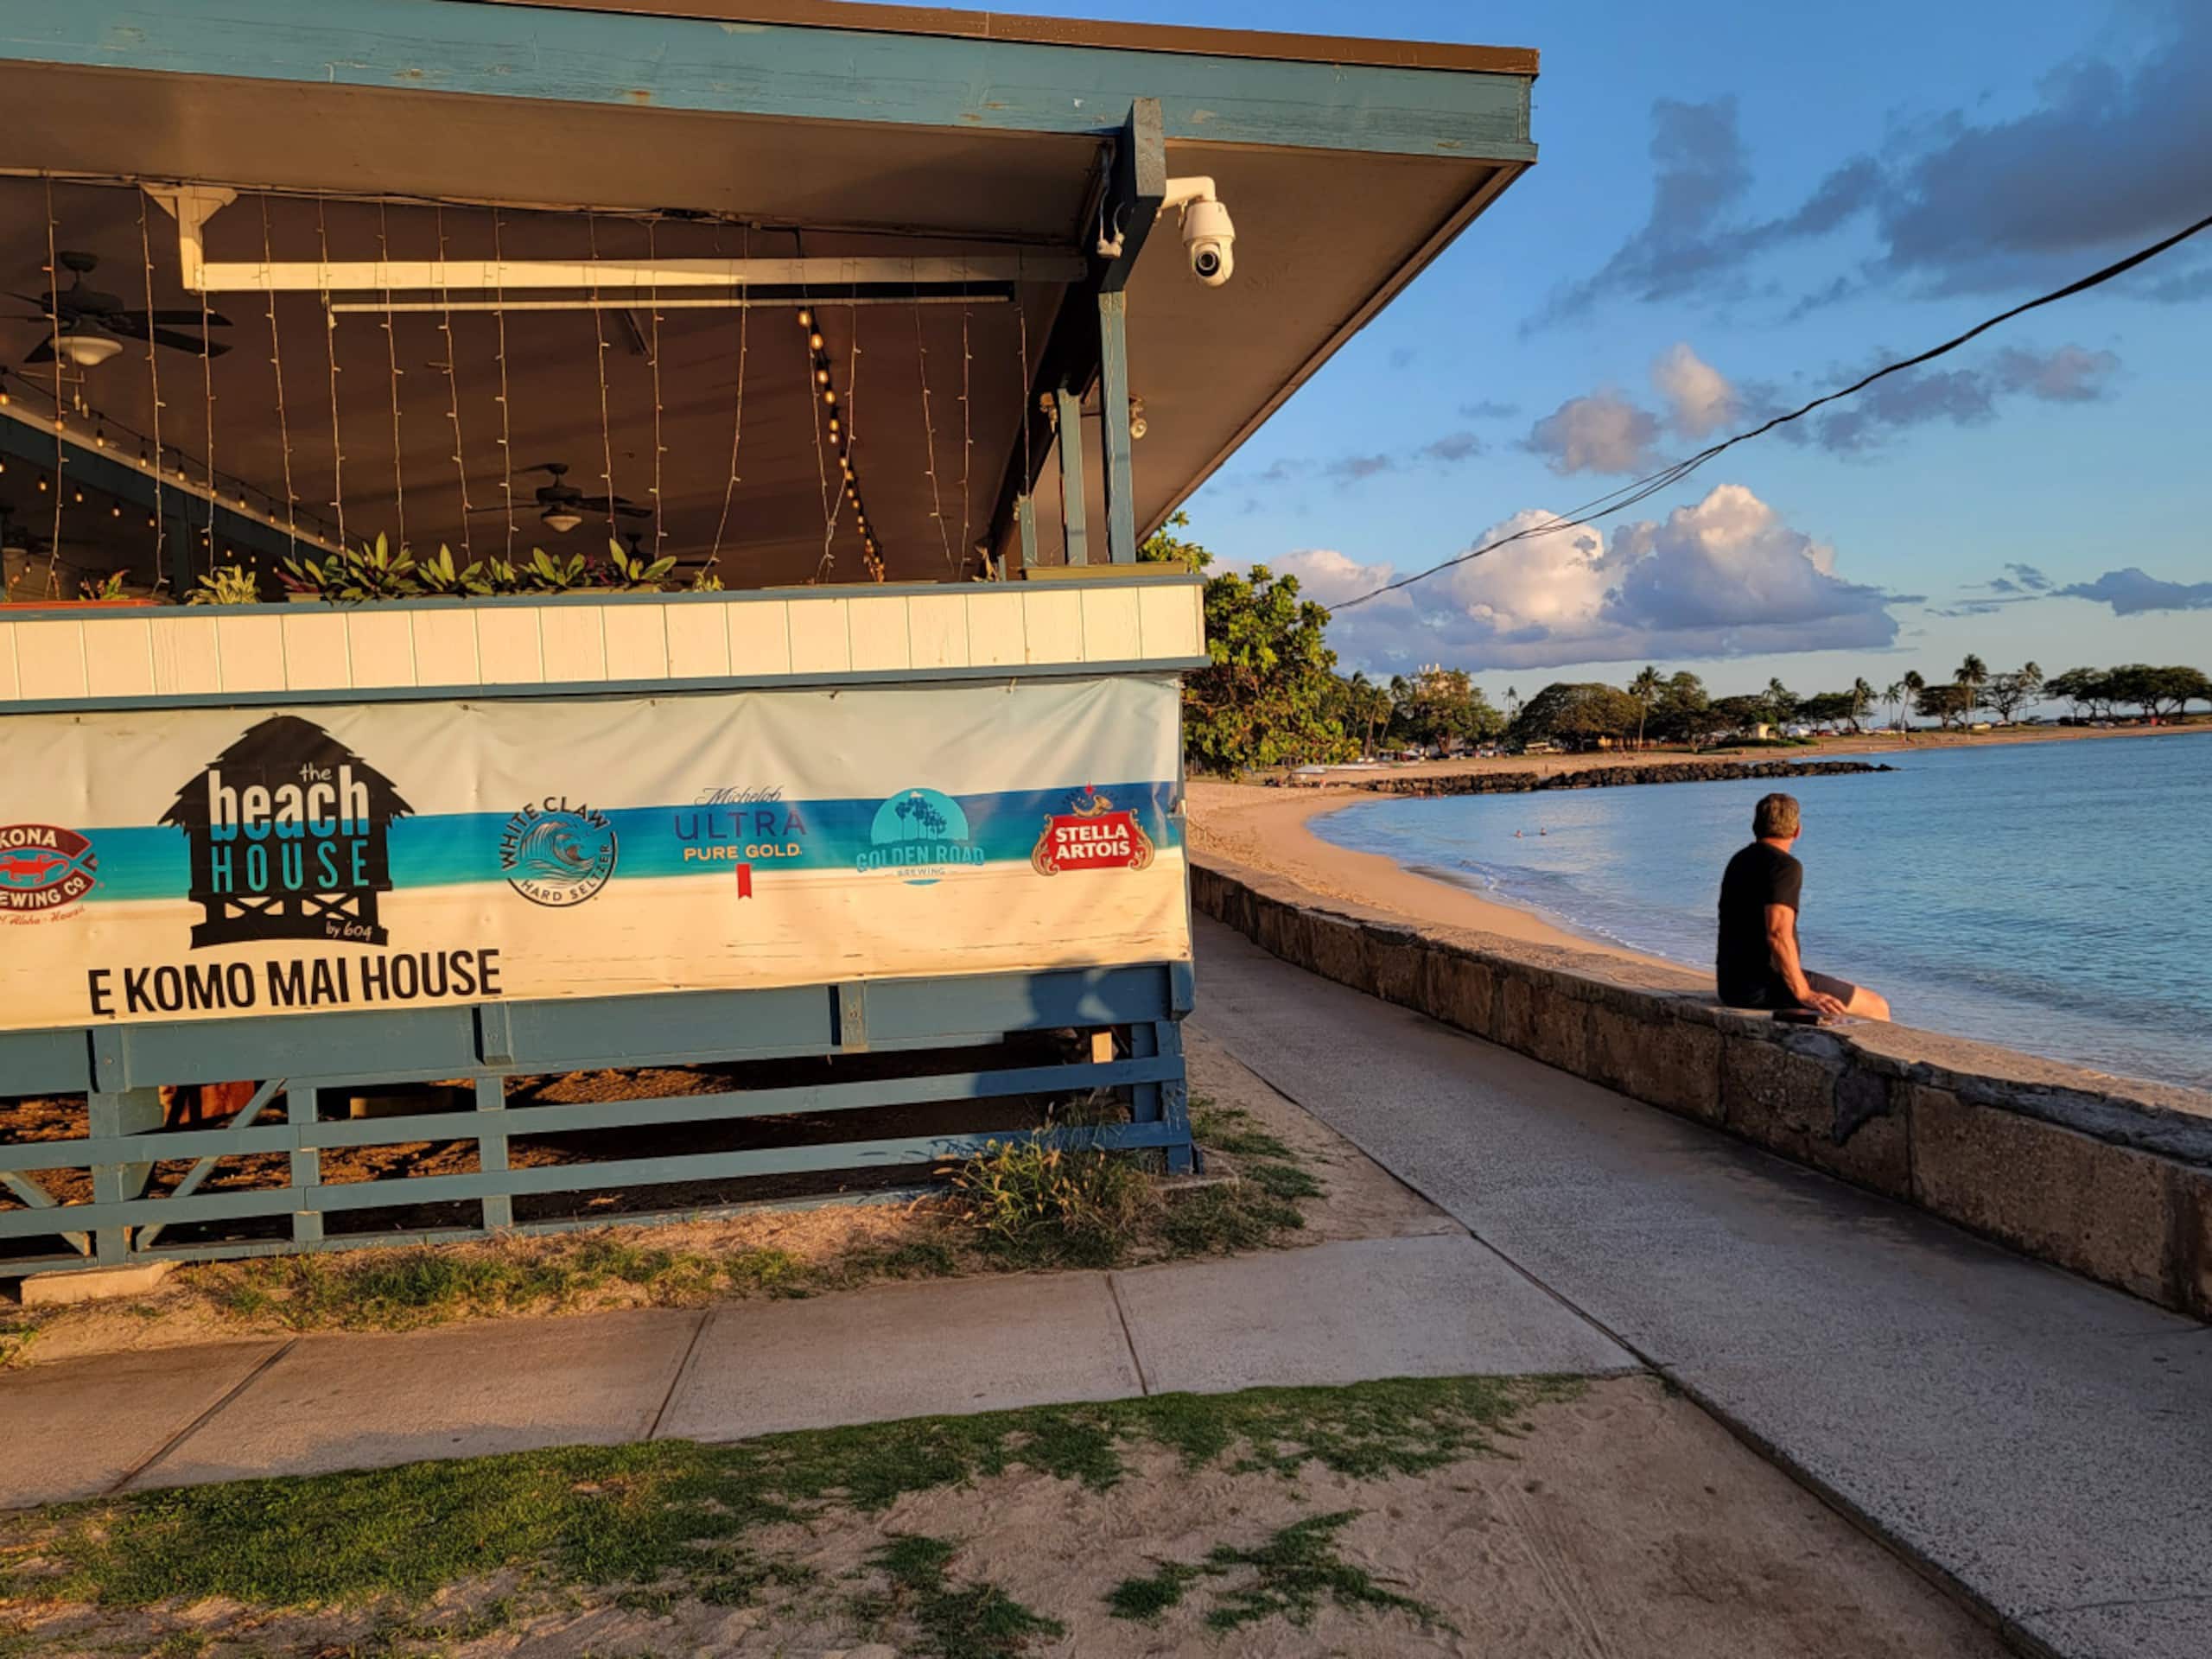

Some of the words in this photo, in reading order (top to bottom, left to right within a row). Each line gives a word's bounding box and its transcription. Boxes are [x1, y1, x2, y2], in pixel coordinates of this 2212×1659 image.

[298, 761, 333, 782] the
[208, 765, 370, 842] beach
[694, 785, 784, 806] Michelob
[499, 803, 540, 871] WHITE
[543, 796, 611, 830] CLAW
[675, 810, 807, 841] ULTRA
[1055, 823, 1129, 842] STELLA
[0, 828, 57, 849] KONA
[1056, 841, 1131, 860] ARTOIS
[683, 845, 739, 861] PURE
[856, 845, 929, 873] GOLDEN
[936, 845, 985, 867] ROAD
[210, 839, 370, 893] HOUSE
[520, 879, 563, 901] HARD
[569, 844, 611, 899] SELTZER
[326, 920, 341, 939] by
[87, 969, 114, 1015] E
[124, 961, 256, 1013] KOMO
[267, 957, 348, 1006] MAI
[359, 949, 502, 1000] HOUSE
